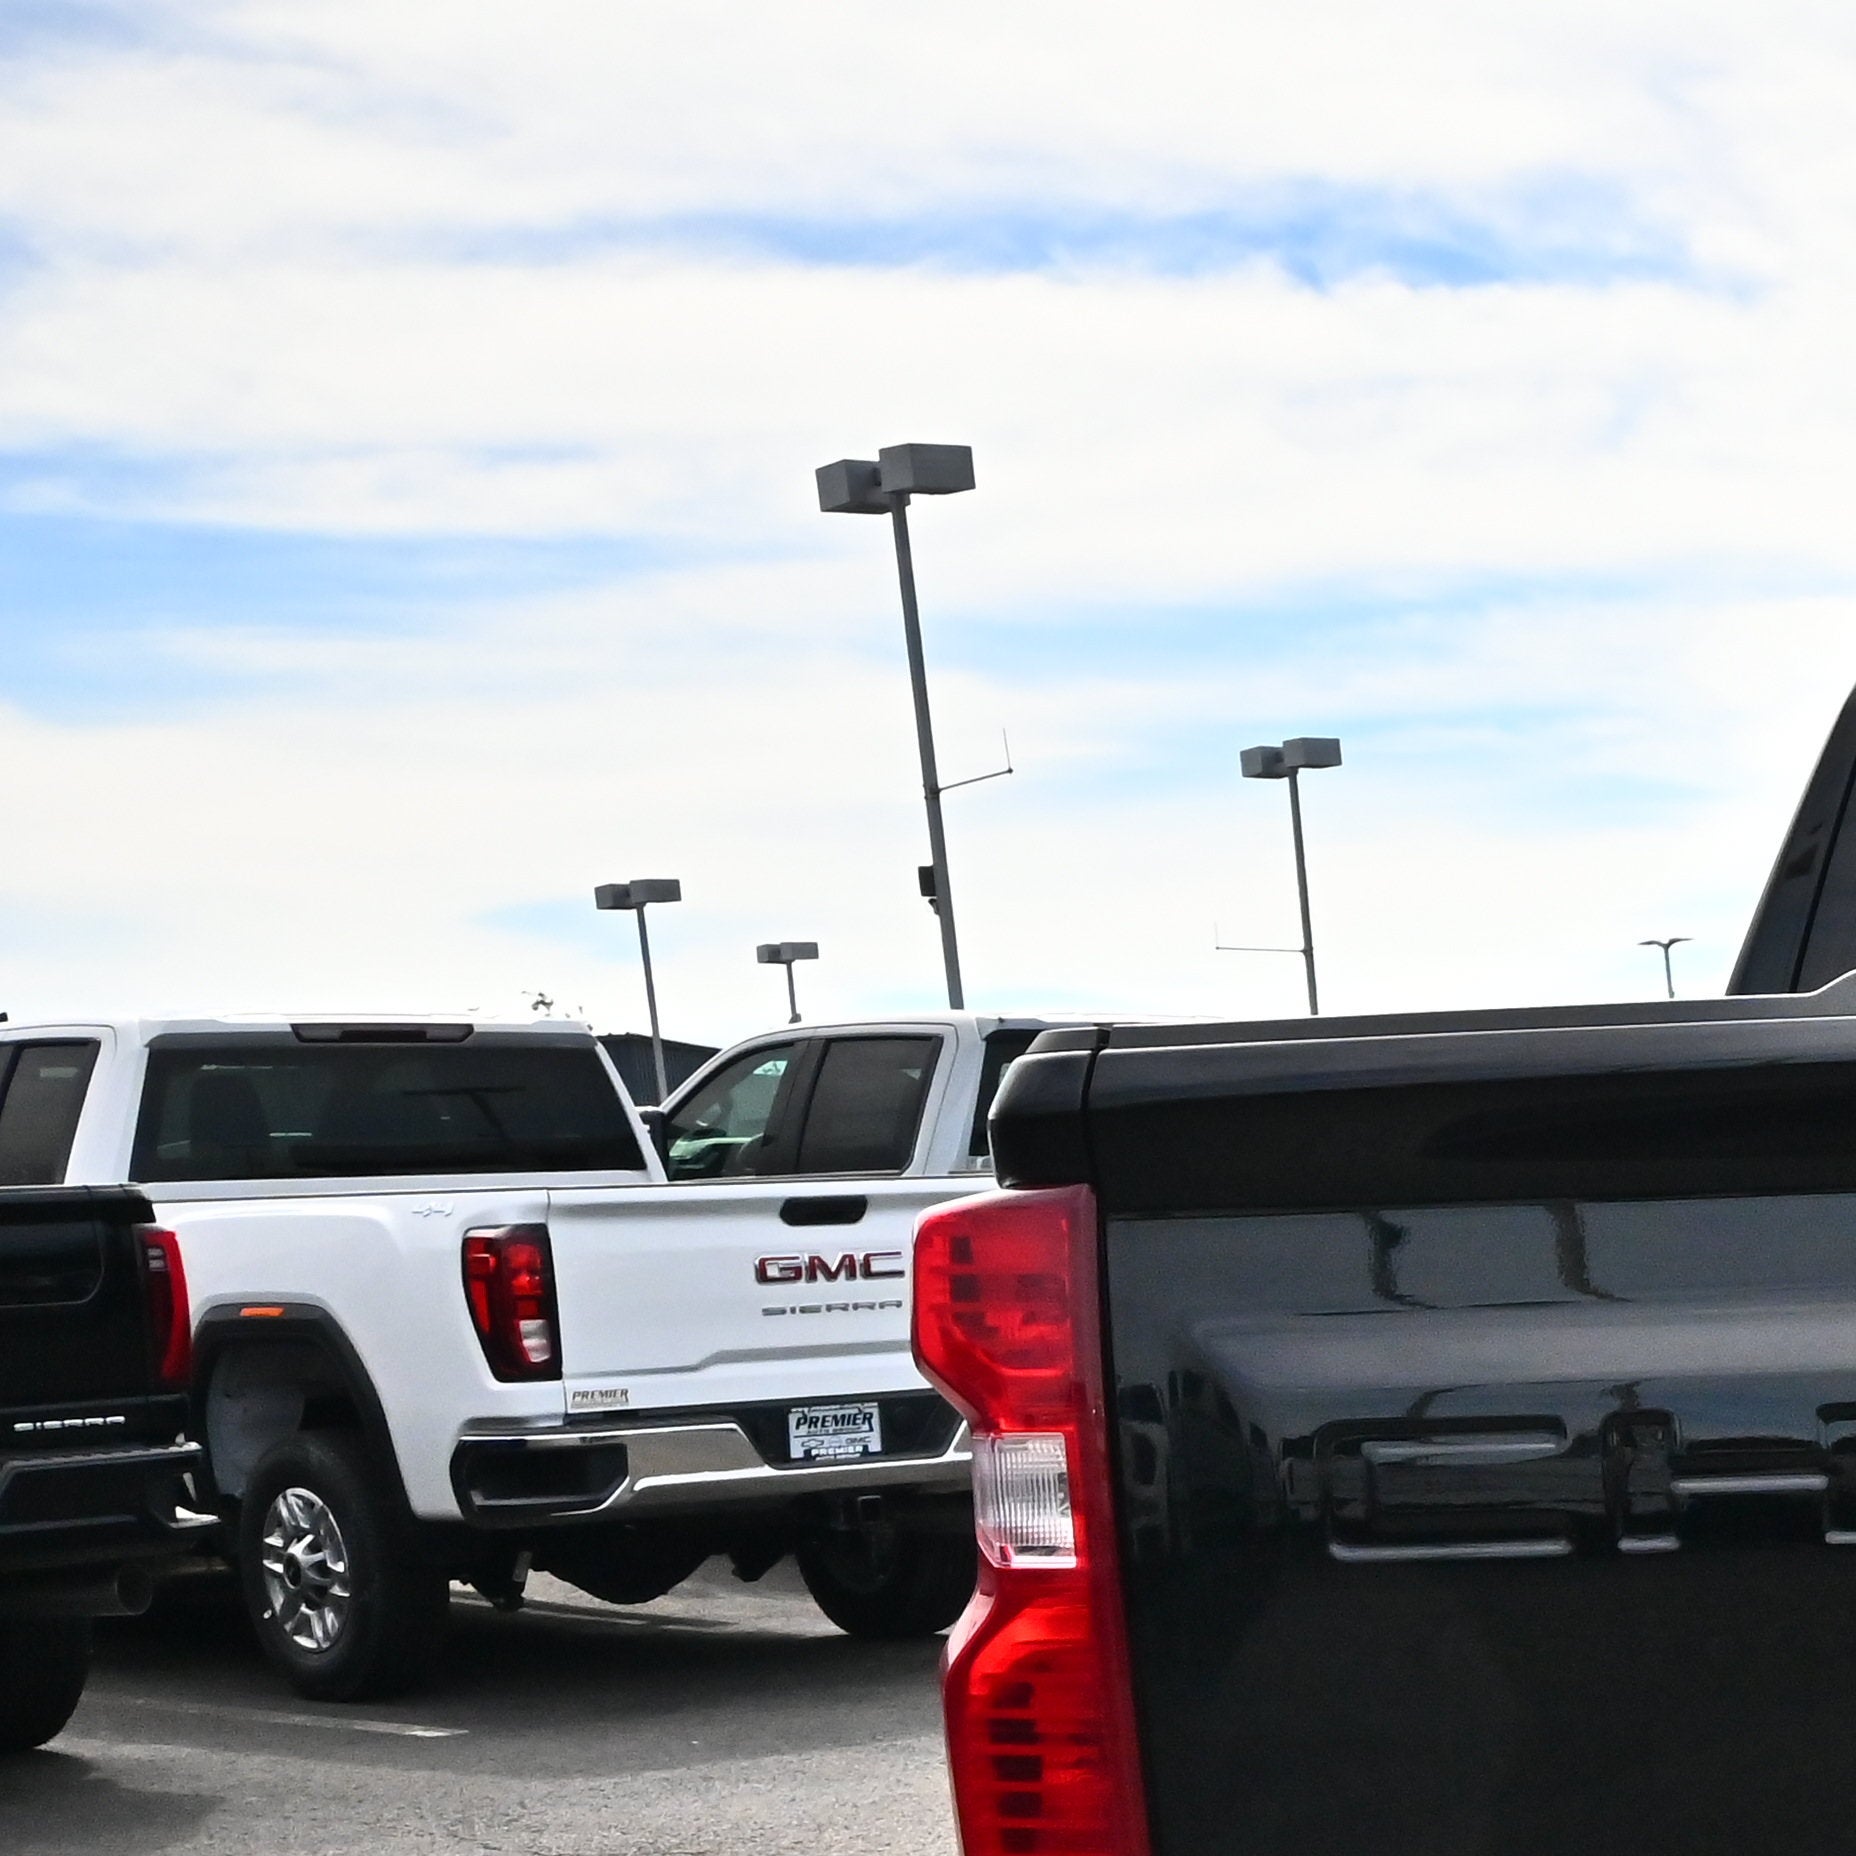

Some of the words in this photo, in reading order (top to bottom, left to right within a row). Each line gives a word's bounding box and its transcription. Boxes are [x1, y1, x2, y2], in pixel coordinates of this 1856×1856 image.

[754, 1251, 905, 1285] GMC
[761, 1300, 903, 1316] SIERRA
[795, 1412, 874, 1432] PREMIER
